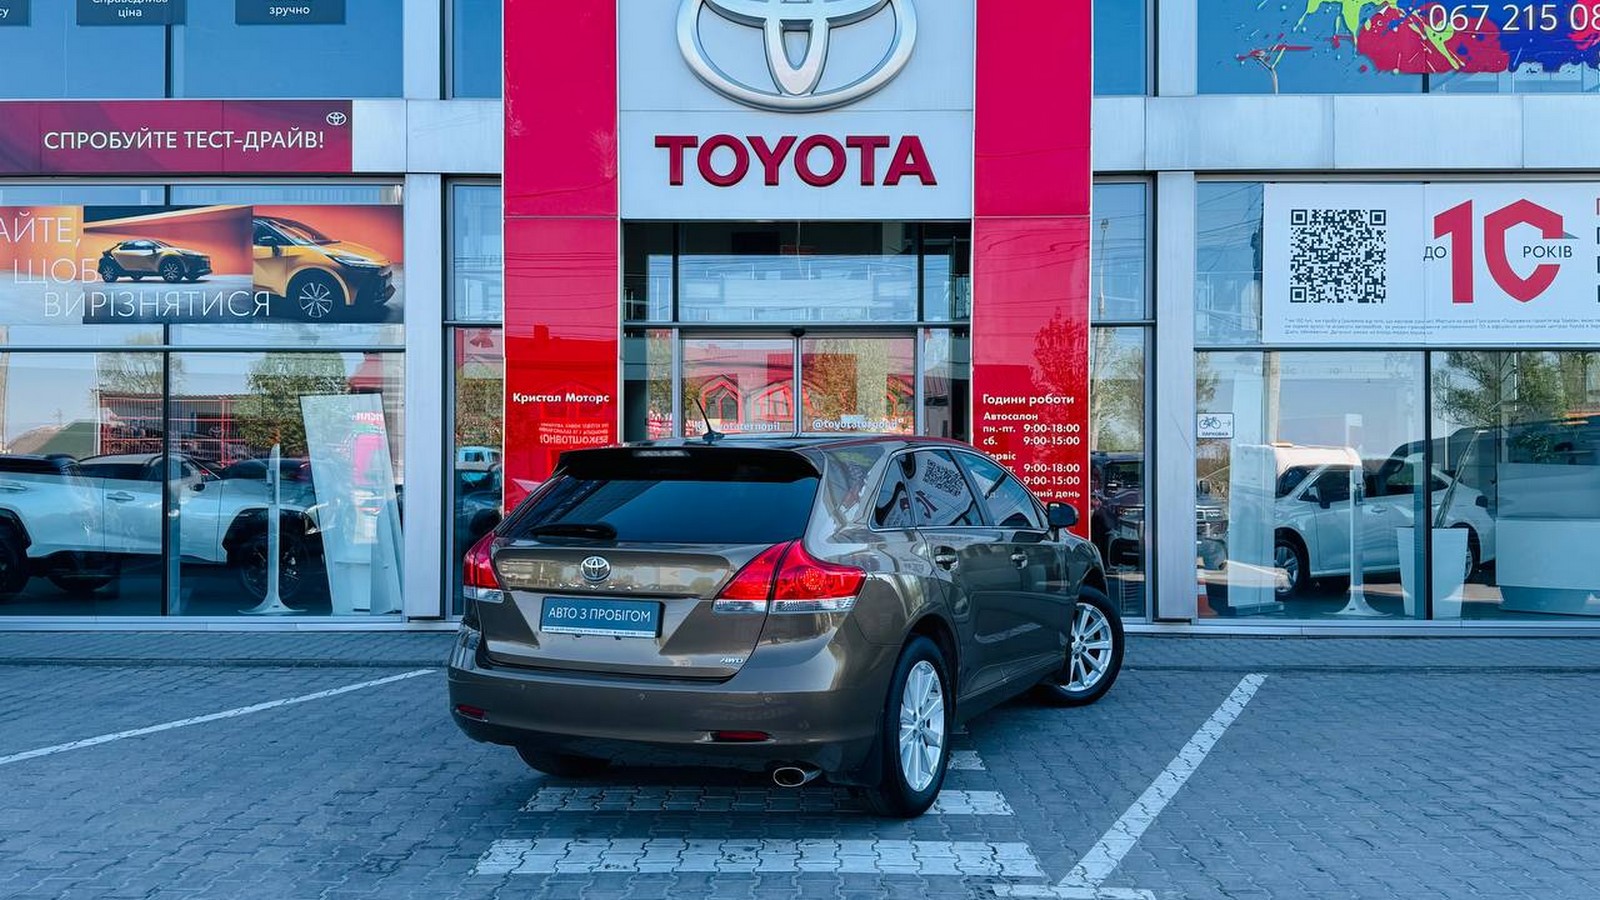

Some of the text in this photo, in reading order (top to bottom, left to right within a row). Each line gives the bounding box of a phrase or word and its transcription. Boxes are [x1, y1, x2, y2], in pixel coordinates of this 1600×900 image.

[118, 7, 142, 18] ціна
[269, 6, 311, 16] зручно
[1429, 4, 1489, 31] 067
[1502, 4, 1557, 31] 215
[44, 127, 324, 152] СПРОБУЙТЕ ТЕСТ-ДРАЙВ!
[654, 134, 938, 187] TOYOTA
[1423, 246, 1447, 261] ДО
[1523, 245, 1573, 259] РОКІВ
[14, 258, 97, 288] ЩОБ
[44, 290, 270, 317] ВИРІЗНЯТИСЯ
[513, 393, 610, 404] Кристал Моторс
[983, 393, 1075, 406] Години роботи
[983, 412, 1038, 420] Автосалон
[1023, 424, 1080, 433] 9:00-18:00
[983, 436, 1080, 445] сб. 9:00-15:00
[985, 451, 1016, 462] ервіс
[1023, 463, 1080, 473] 9:00-18:00
[1023, 476, 1080, 485] 9:00-15:00
[1055, 490, 1081, 499] день
[548, 607, 578, 619] АВТО
[589, 608, 651, 622] ПРОБІГОМ
